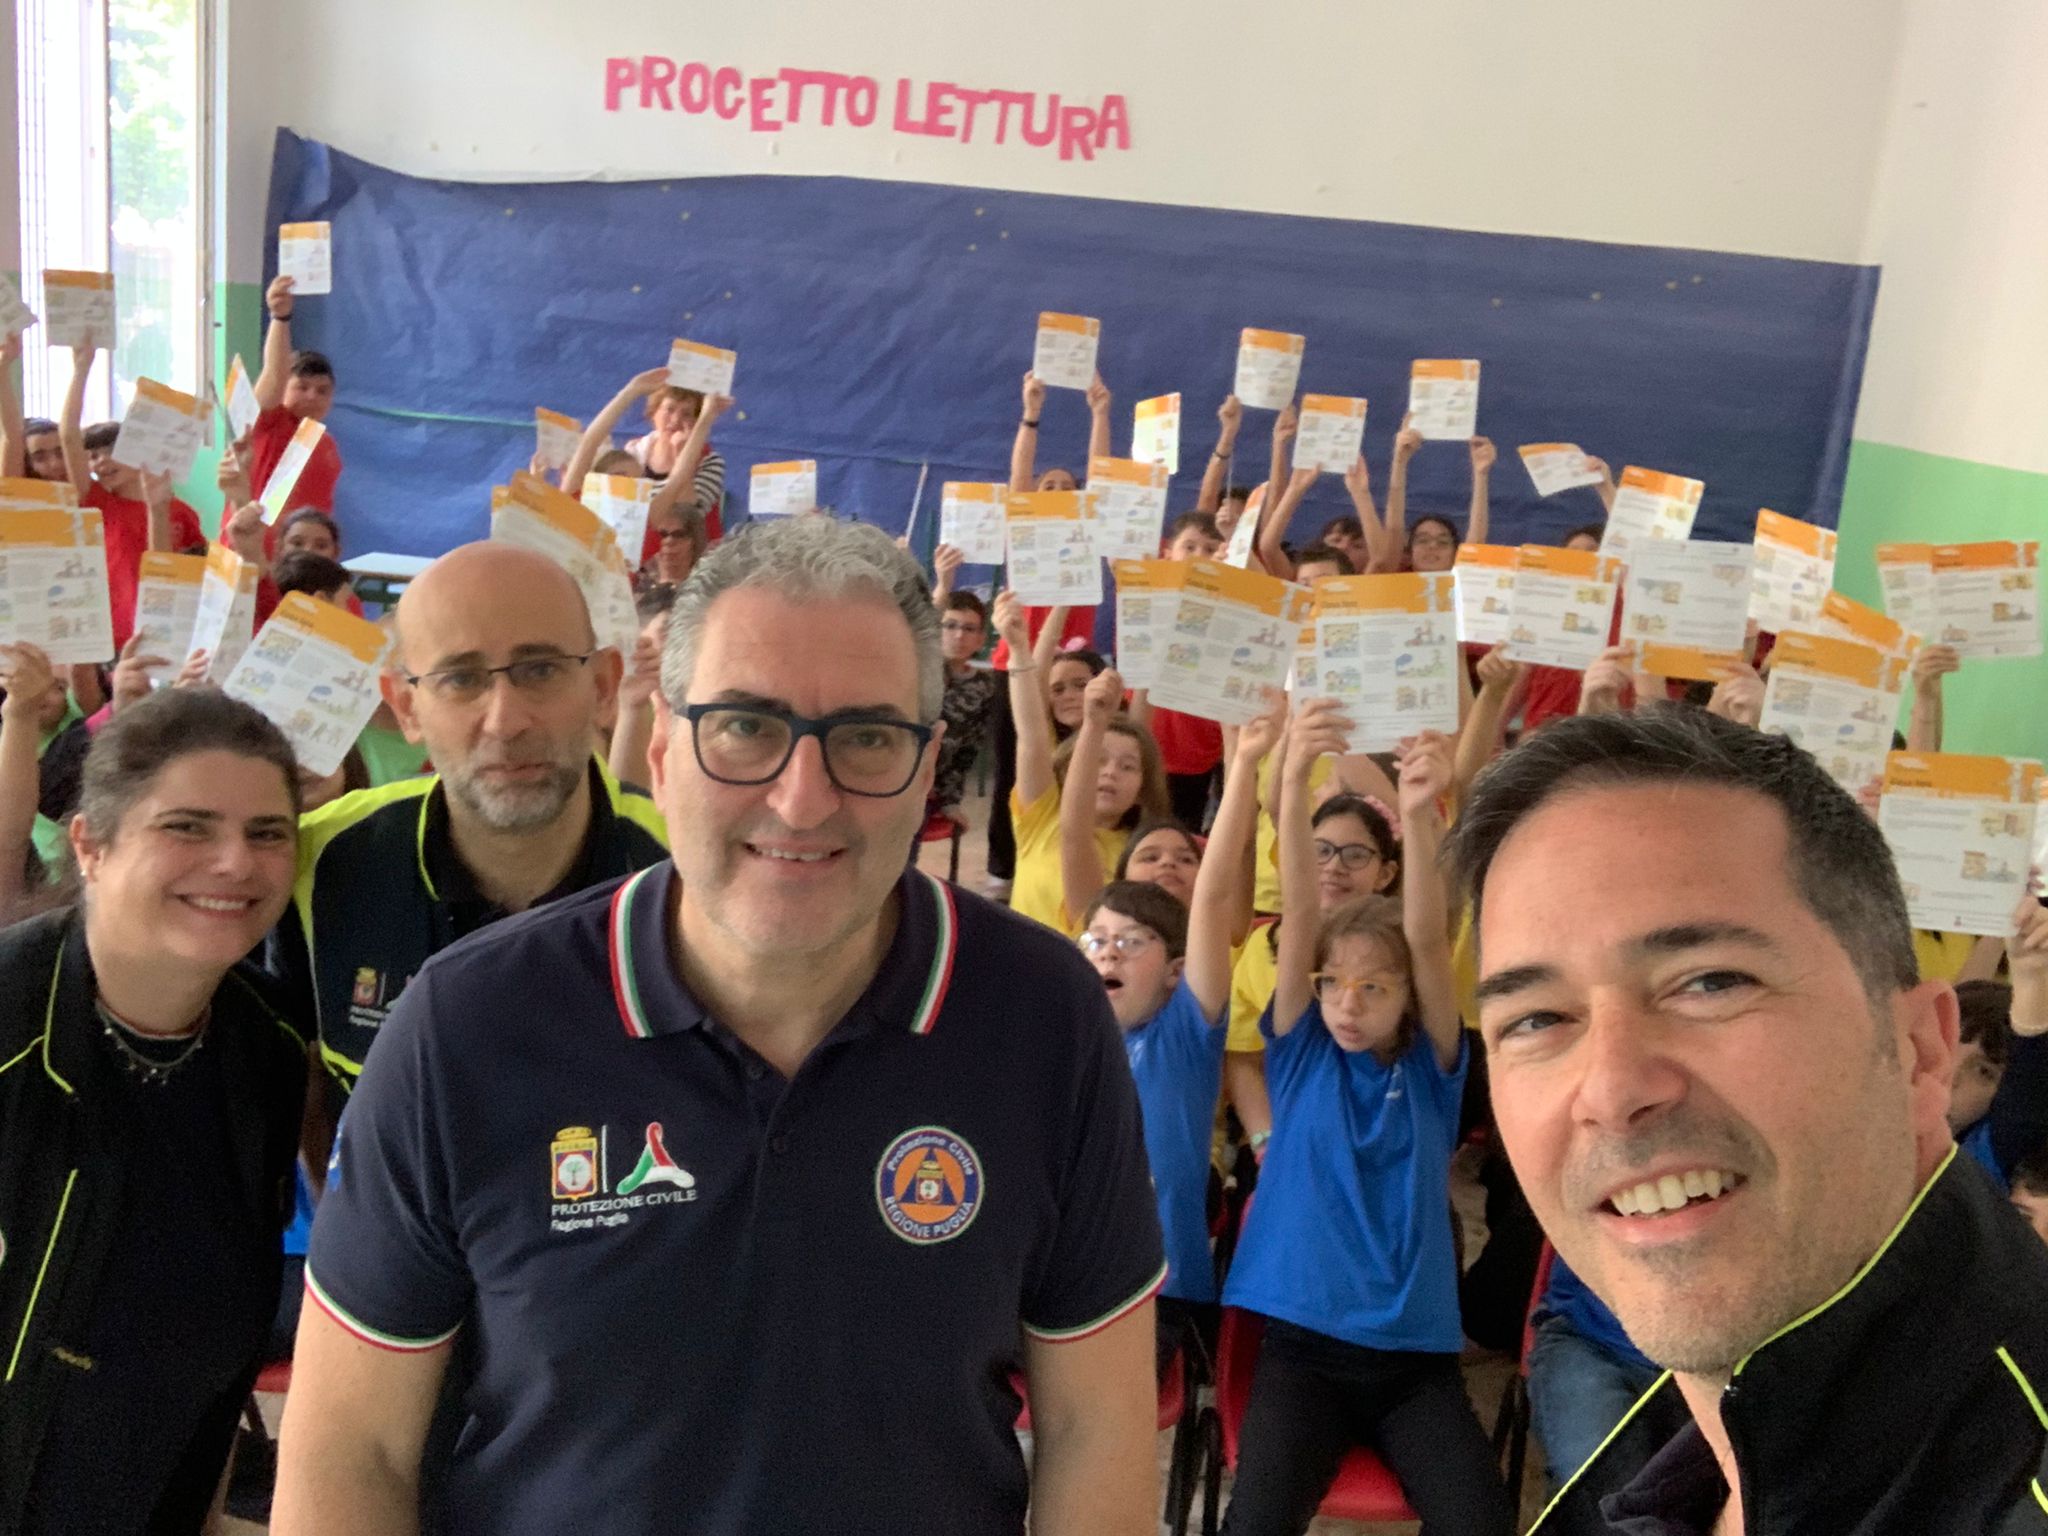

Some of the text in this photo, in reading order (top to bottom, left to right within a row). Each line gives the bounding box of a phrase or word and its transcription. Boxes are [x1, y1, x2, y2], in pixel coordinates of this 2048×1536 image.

[604, 55, 1131, 161] PROGETTO LETTURA
[551, 1189, 697, 1216] PROTEZIONE CIVILE
[885, 1196, 974, 1237] REGIONE PUGLIA
